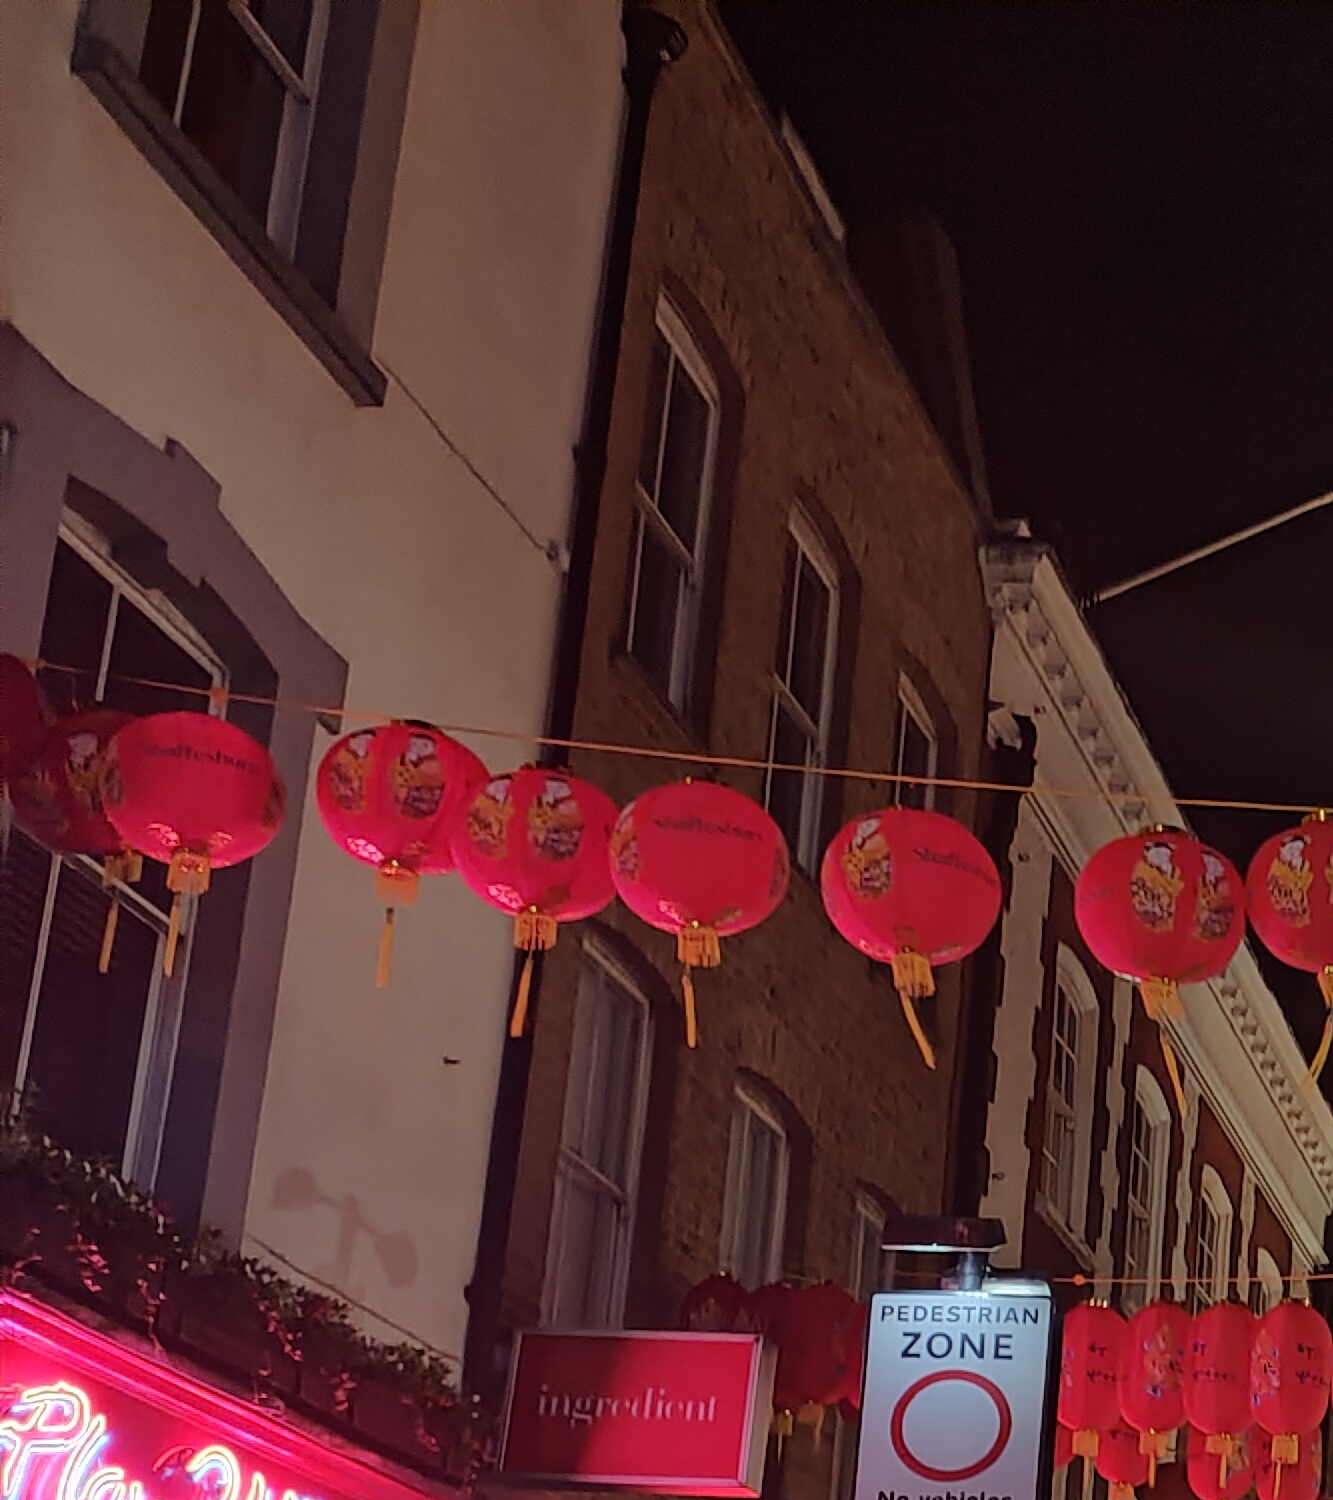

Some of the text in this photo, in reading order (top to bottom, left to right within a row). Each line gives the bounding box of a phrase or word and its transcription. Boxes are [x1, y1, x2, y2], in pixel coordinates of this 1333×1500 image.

[880, 1305, 1040, 1325] PEDESTRIAN
[900, 1331, 1014, 1361] ZONE
[537, 1383, 717, 1429] ingredient
